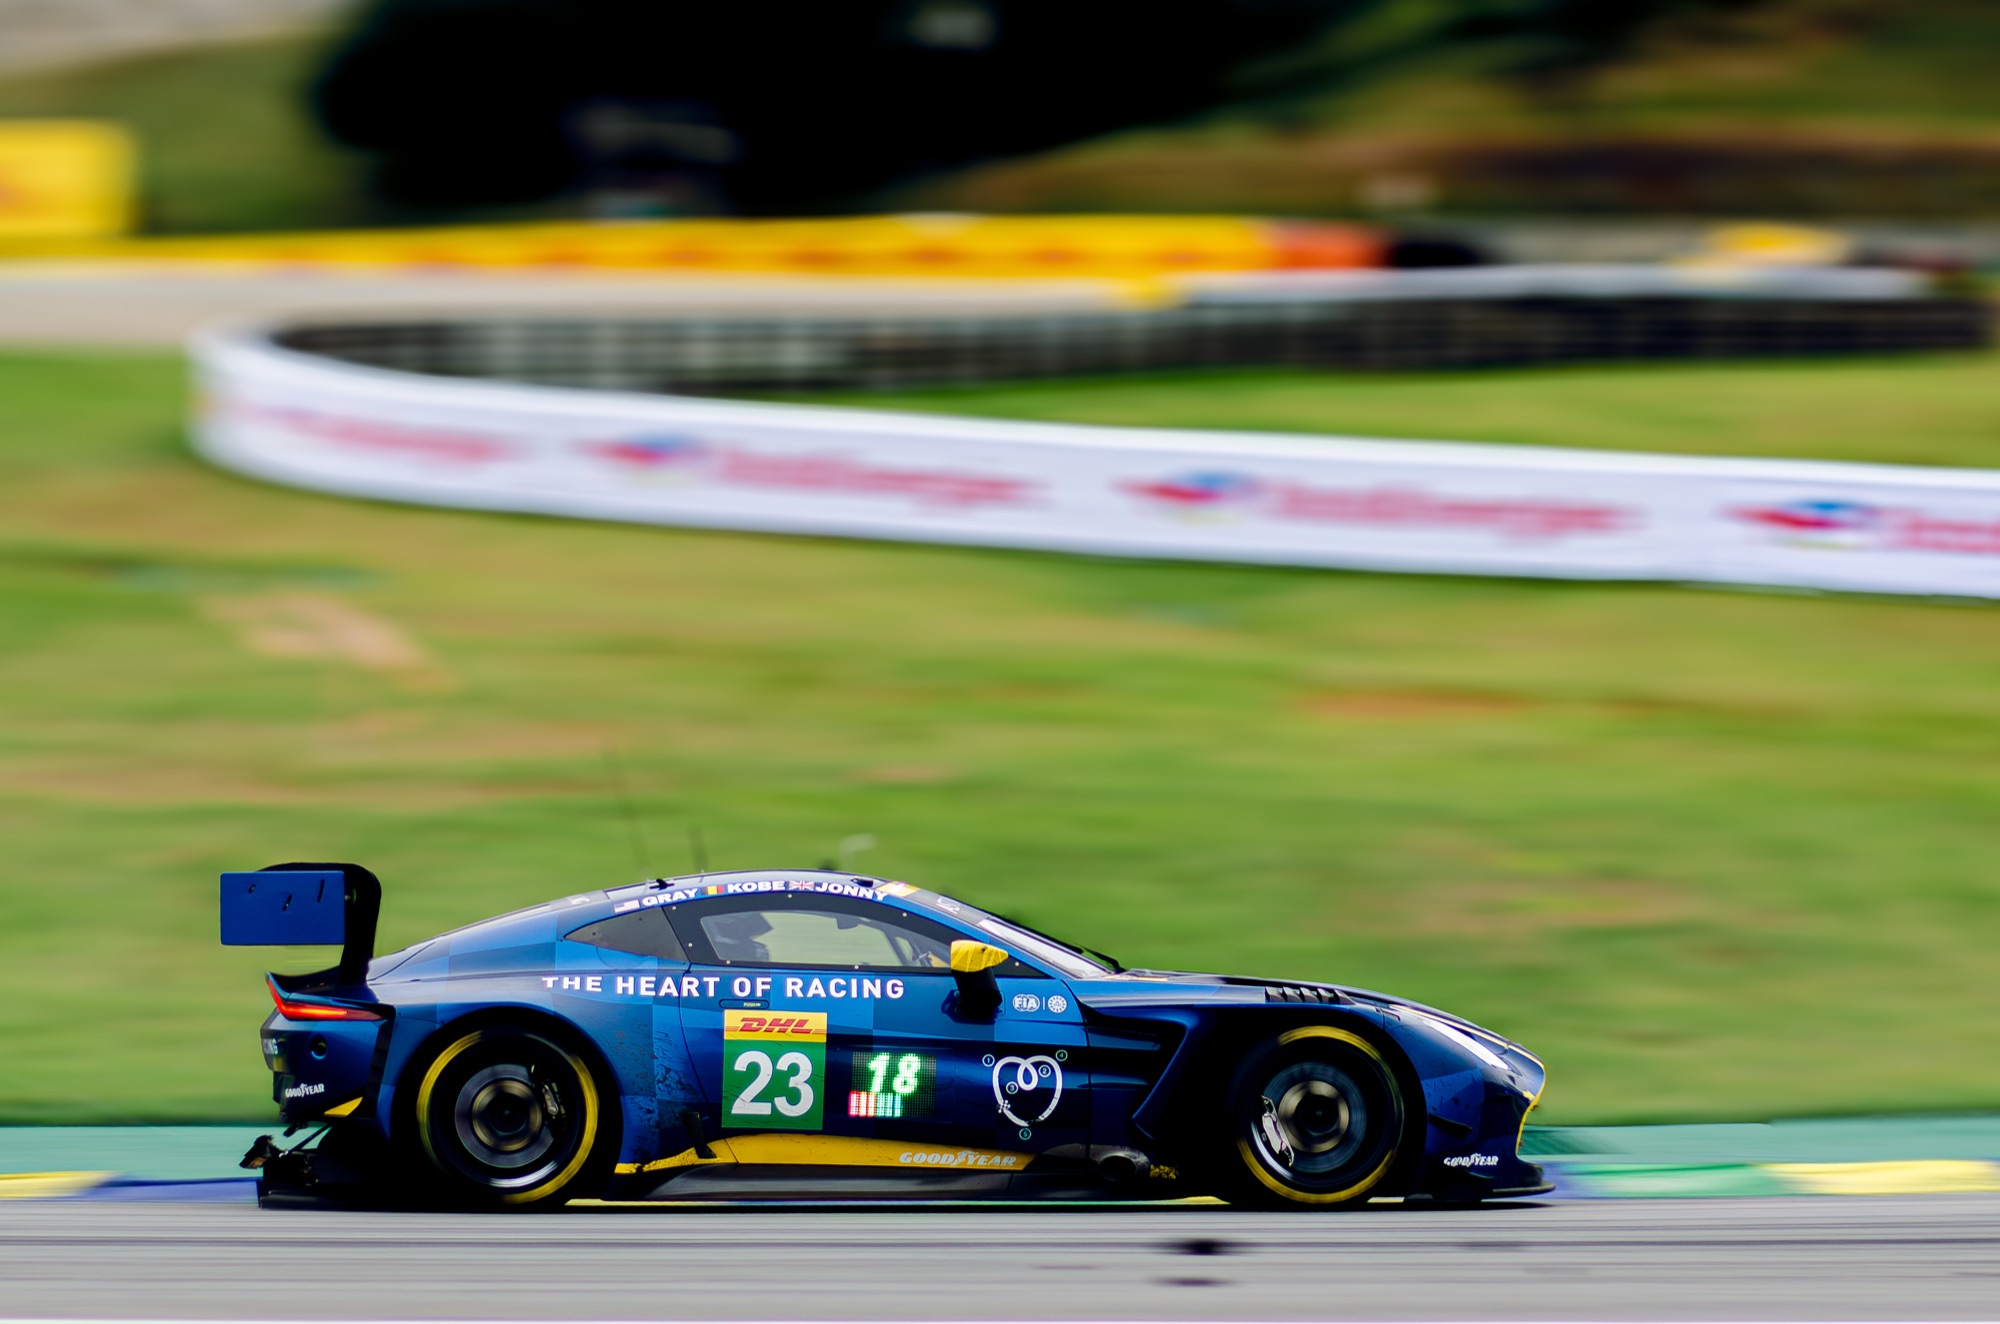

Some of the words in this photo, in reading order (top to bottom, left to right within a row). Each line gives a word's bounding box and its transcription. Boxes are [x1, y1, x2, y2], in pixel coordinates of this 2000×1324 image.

[642, 888, 699, 906] GRAY
[727, 881, 786, 893] KOBE
[815, 882, 888, 901] JONNY
[541, 976, 603, 992] THE
[616, 976, 721, 998] HEART
[733, 977, 772, 997] OF
[786, 977, 905, 999] RACING
[1014, 997, 1038, 1009] FIA
[739, 1017, 813, 1035] DHL
[731, 1050, 814, 1117] 23
[868, 1052, 921, 1097] 18
[285, 1083, 325, 1098] GOODYEAR
[899, 1150, 1017, 1167] GOODYEAR
[1443, 1152, 1499, 1168] GOODYEAR
